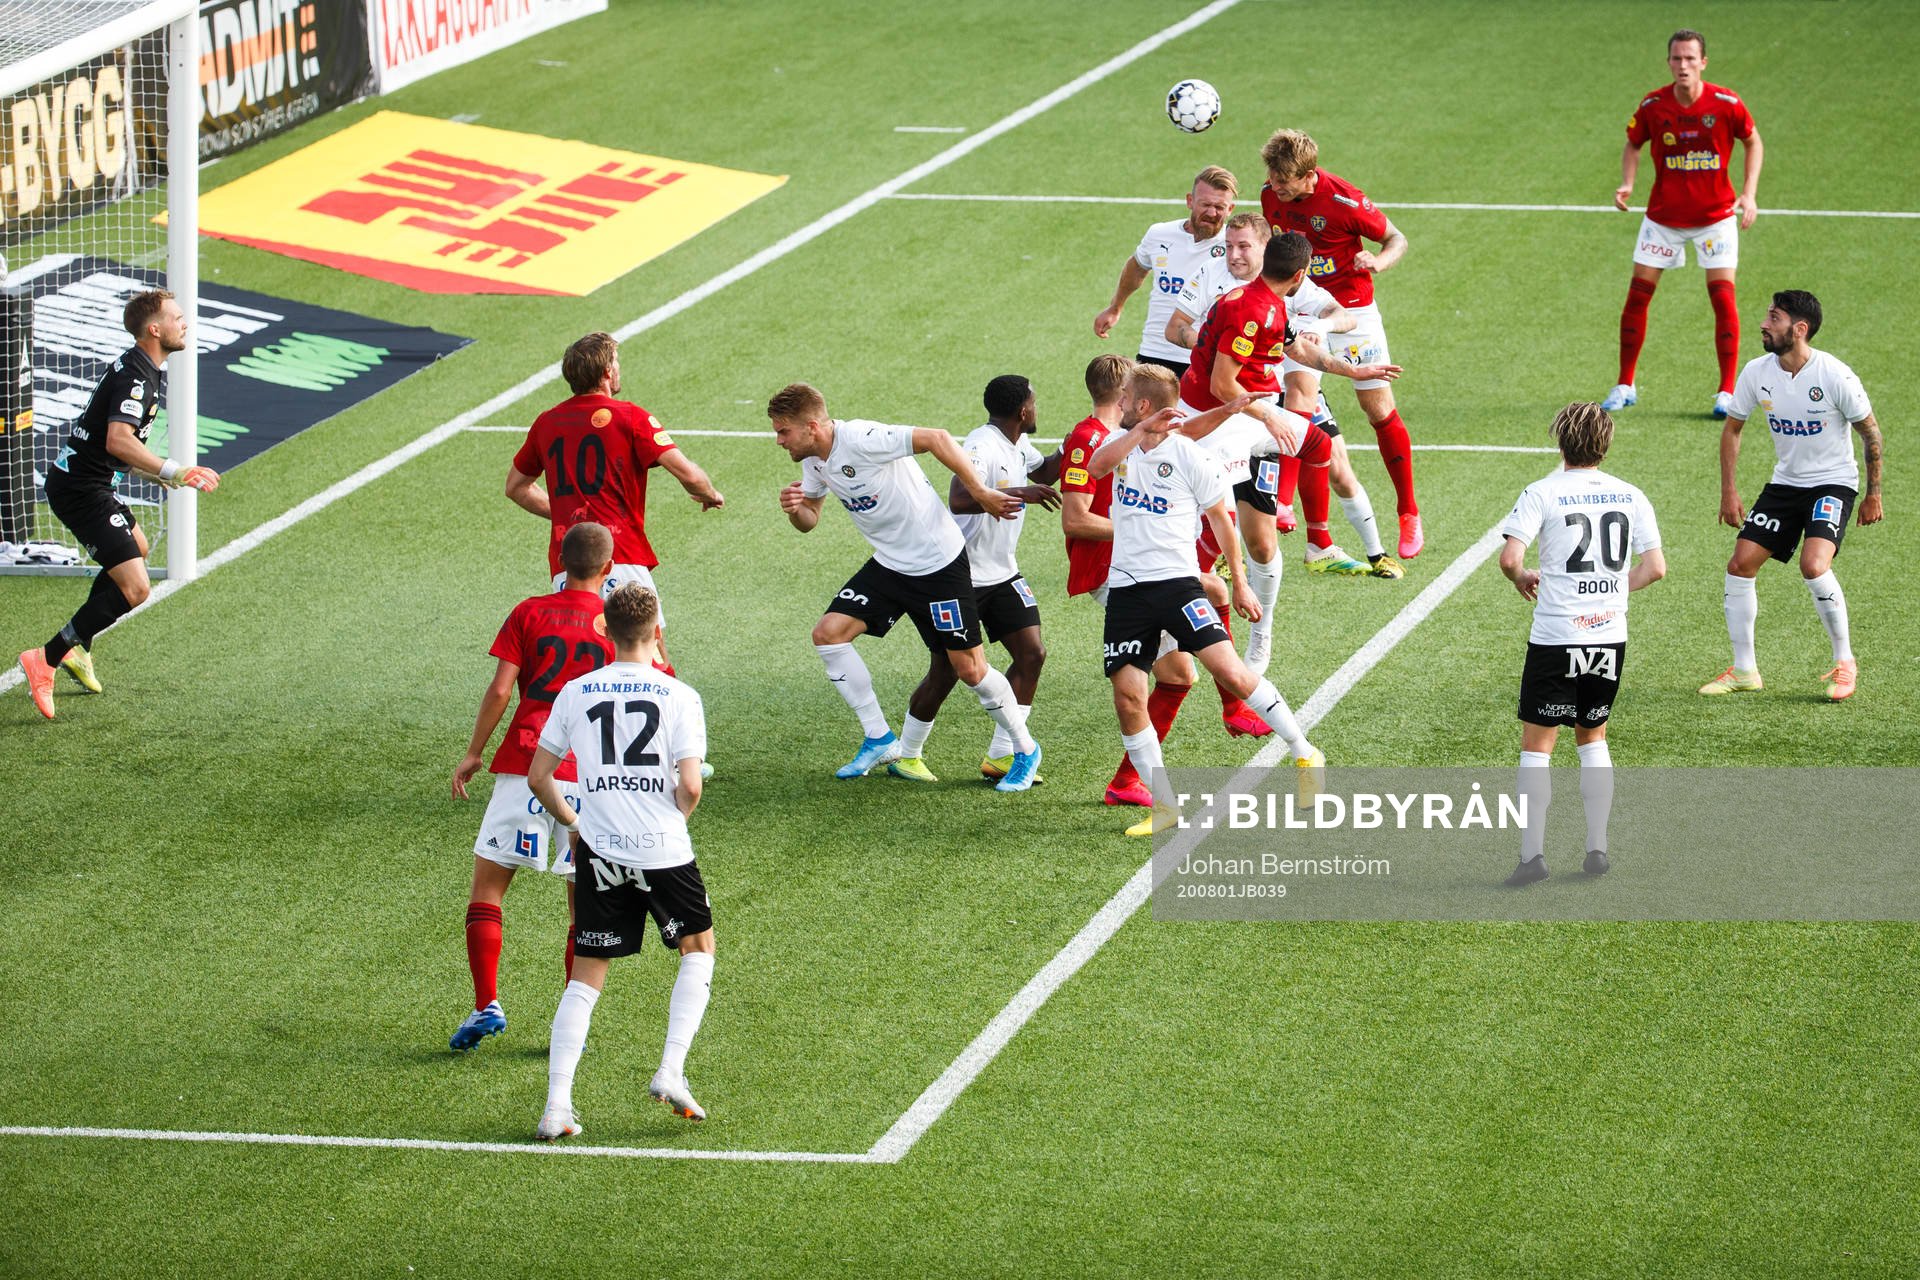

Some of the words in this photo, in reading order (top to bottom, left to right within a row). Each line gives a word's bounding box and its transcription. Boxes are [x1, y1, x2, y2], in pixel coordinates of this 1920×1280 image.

[0, 65, 126, 226] -BYGG
[1159, 271, 1184, 295] ÖB
[1769, 414, 1823, 437] ÖBAB
[547, 433, 606, 497] 10
[1558, 493, 1633, 506] MALMBERGS
[1565, 511, 1630, 574] 20
[1578, 579, 1619, 594] BOOK
[1565, 647, 1618, 681] NA
[582, 682, 670, 697] MALMBERGS
[586, 700, 660, 767] 12
[586, 776, 665, 793] LARSSON
[596, 832, 668, 850] ERNST
[577, 936, 622, 947] WELLNESS
[582, 930, 614, 939] NORDIC
